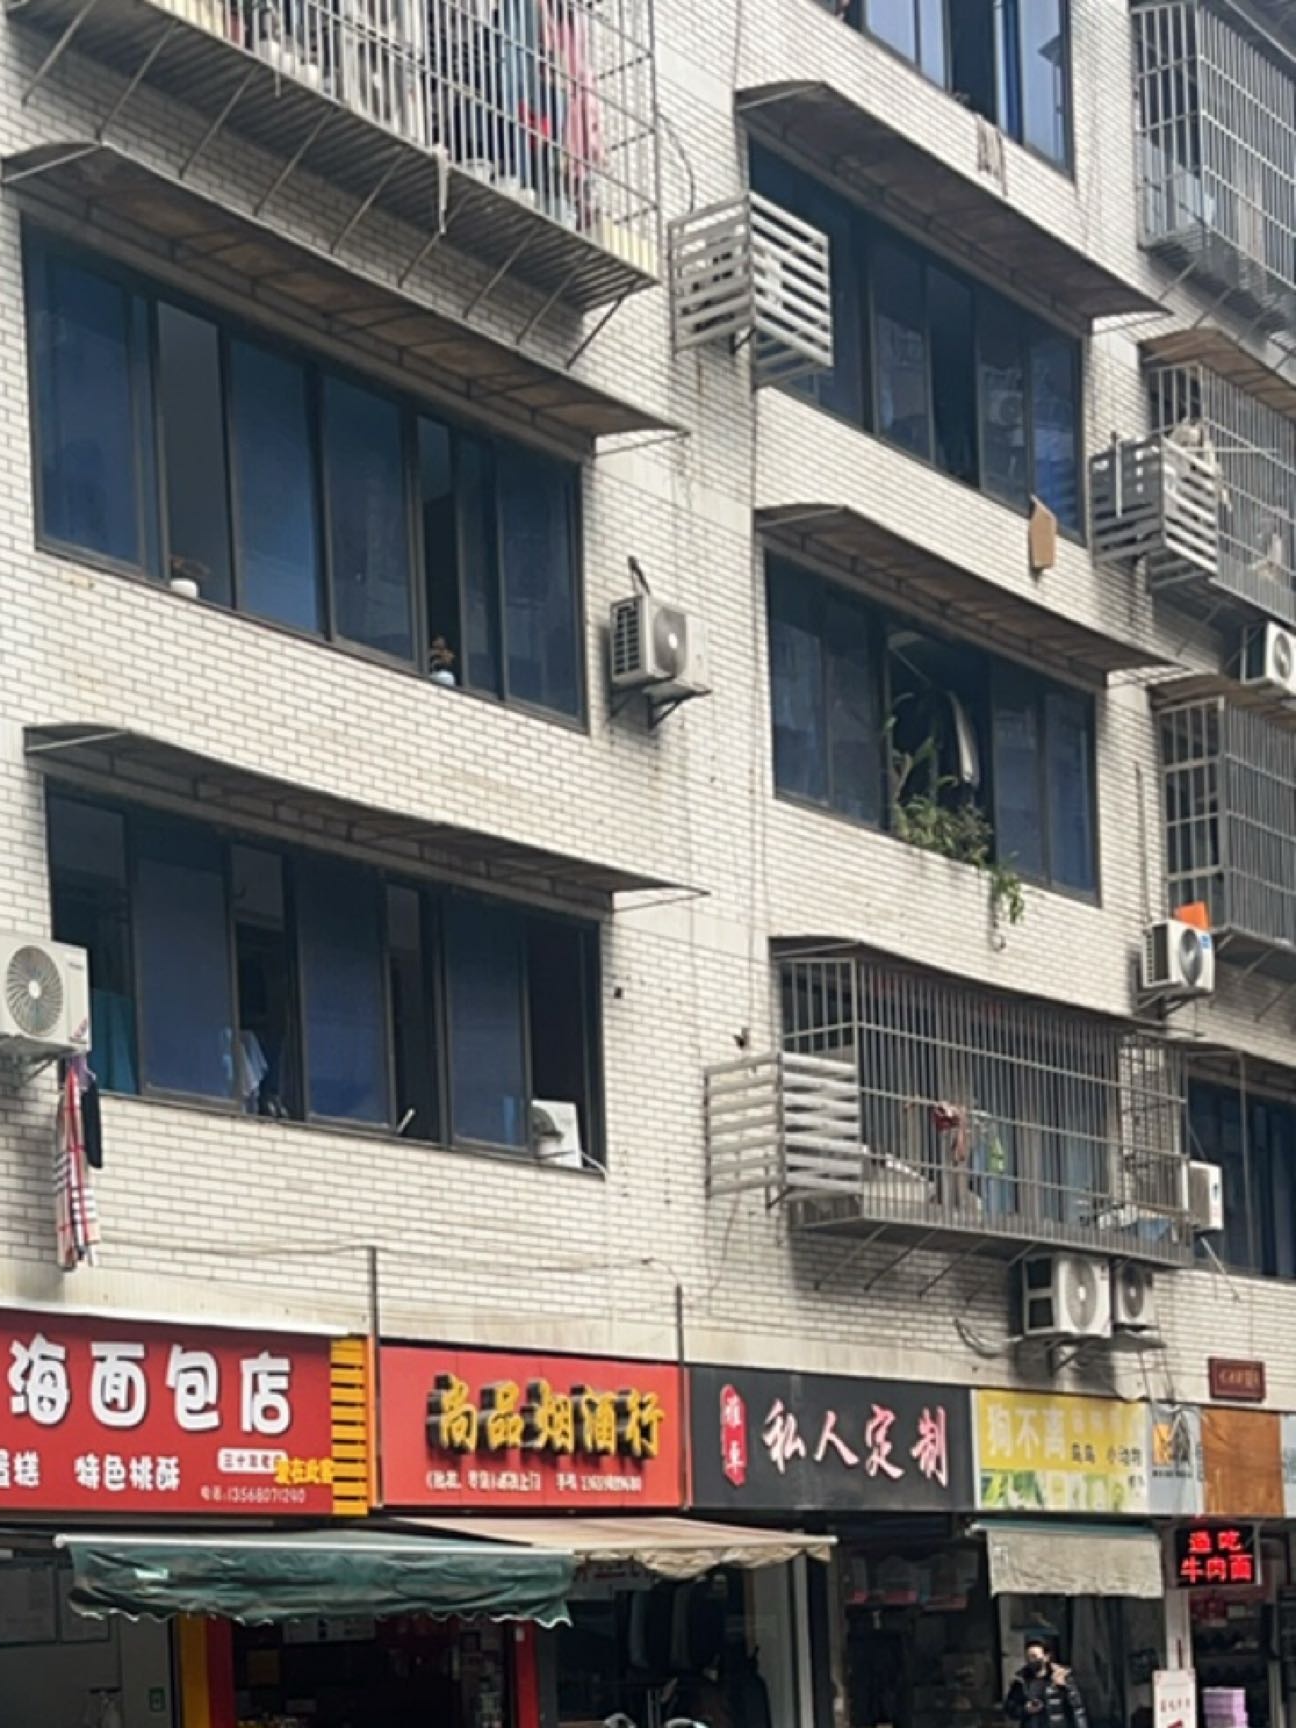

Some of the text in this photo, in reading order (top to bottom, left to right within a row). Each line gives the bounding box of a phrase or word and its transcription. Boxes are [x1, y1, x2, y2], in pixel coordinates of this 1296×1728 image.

[762, 1398, 948, 1488] 私人定制
[1180, 1554, 1252, 1583] 牛肉面
